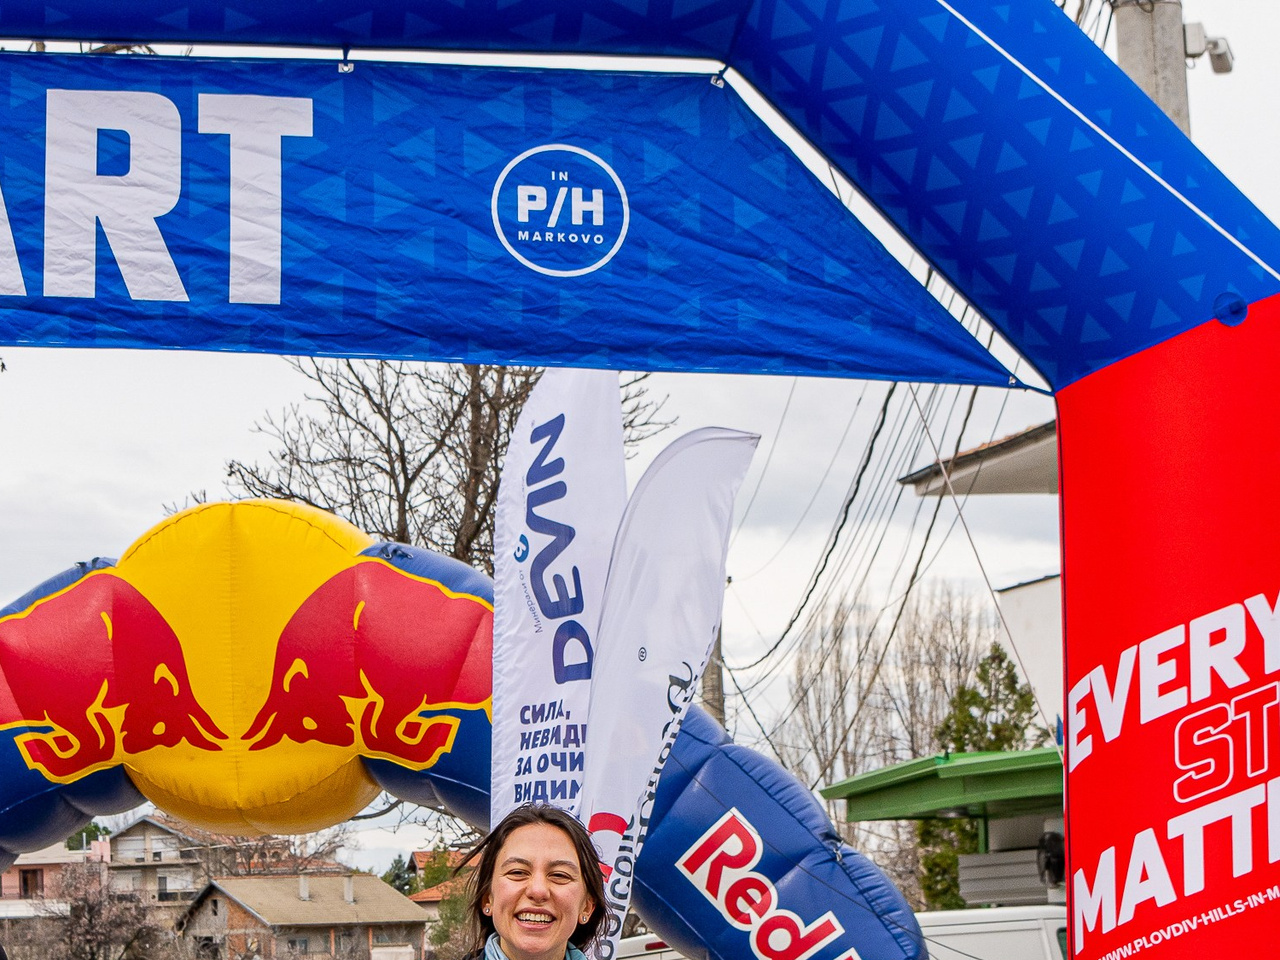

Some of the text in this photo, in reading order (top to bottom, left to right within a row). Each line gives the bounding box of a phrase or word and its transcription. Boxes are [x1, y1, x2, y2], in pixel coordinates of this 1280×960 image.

[551, 171, 568, 181] IN
[517, 185, 604, 228] P/H
[518, 230, 604, 244] MARKOVO
[526, 413, 594, 685] DEVIN
[515, 756, 532, 776] ЗА
[1074, 776, 1280, 956] MATT
